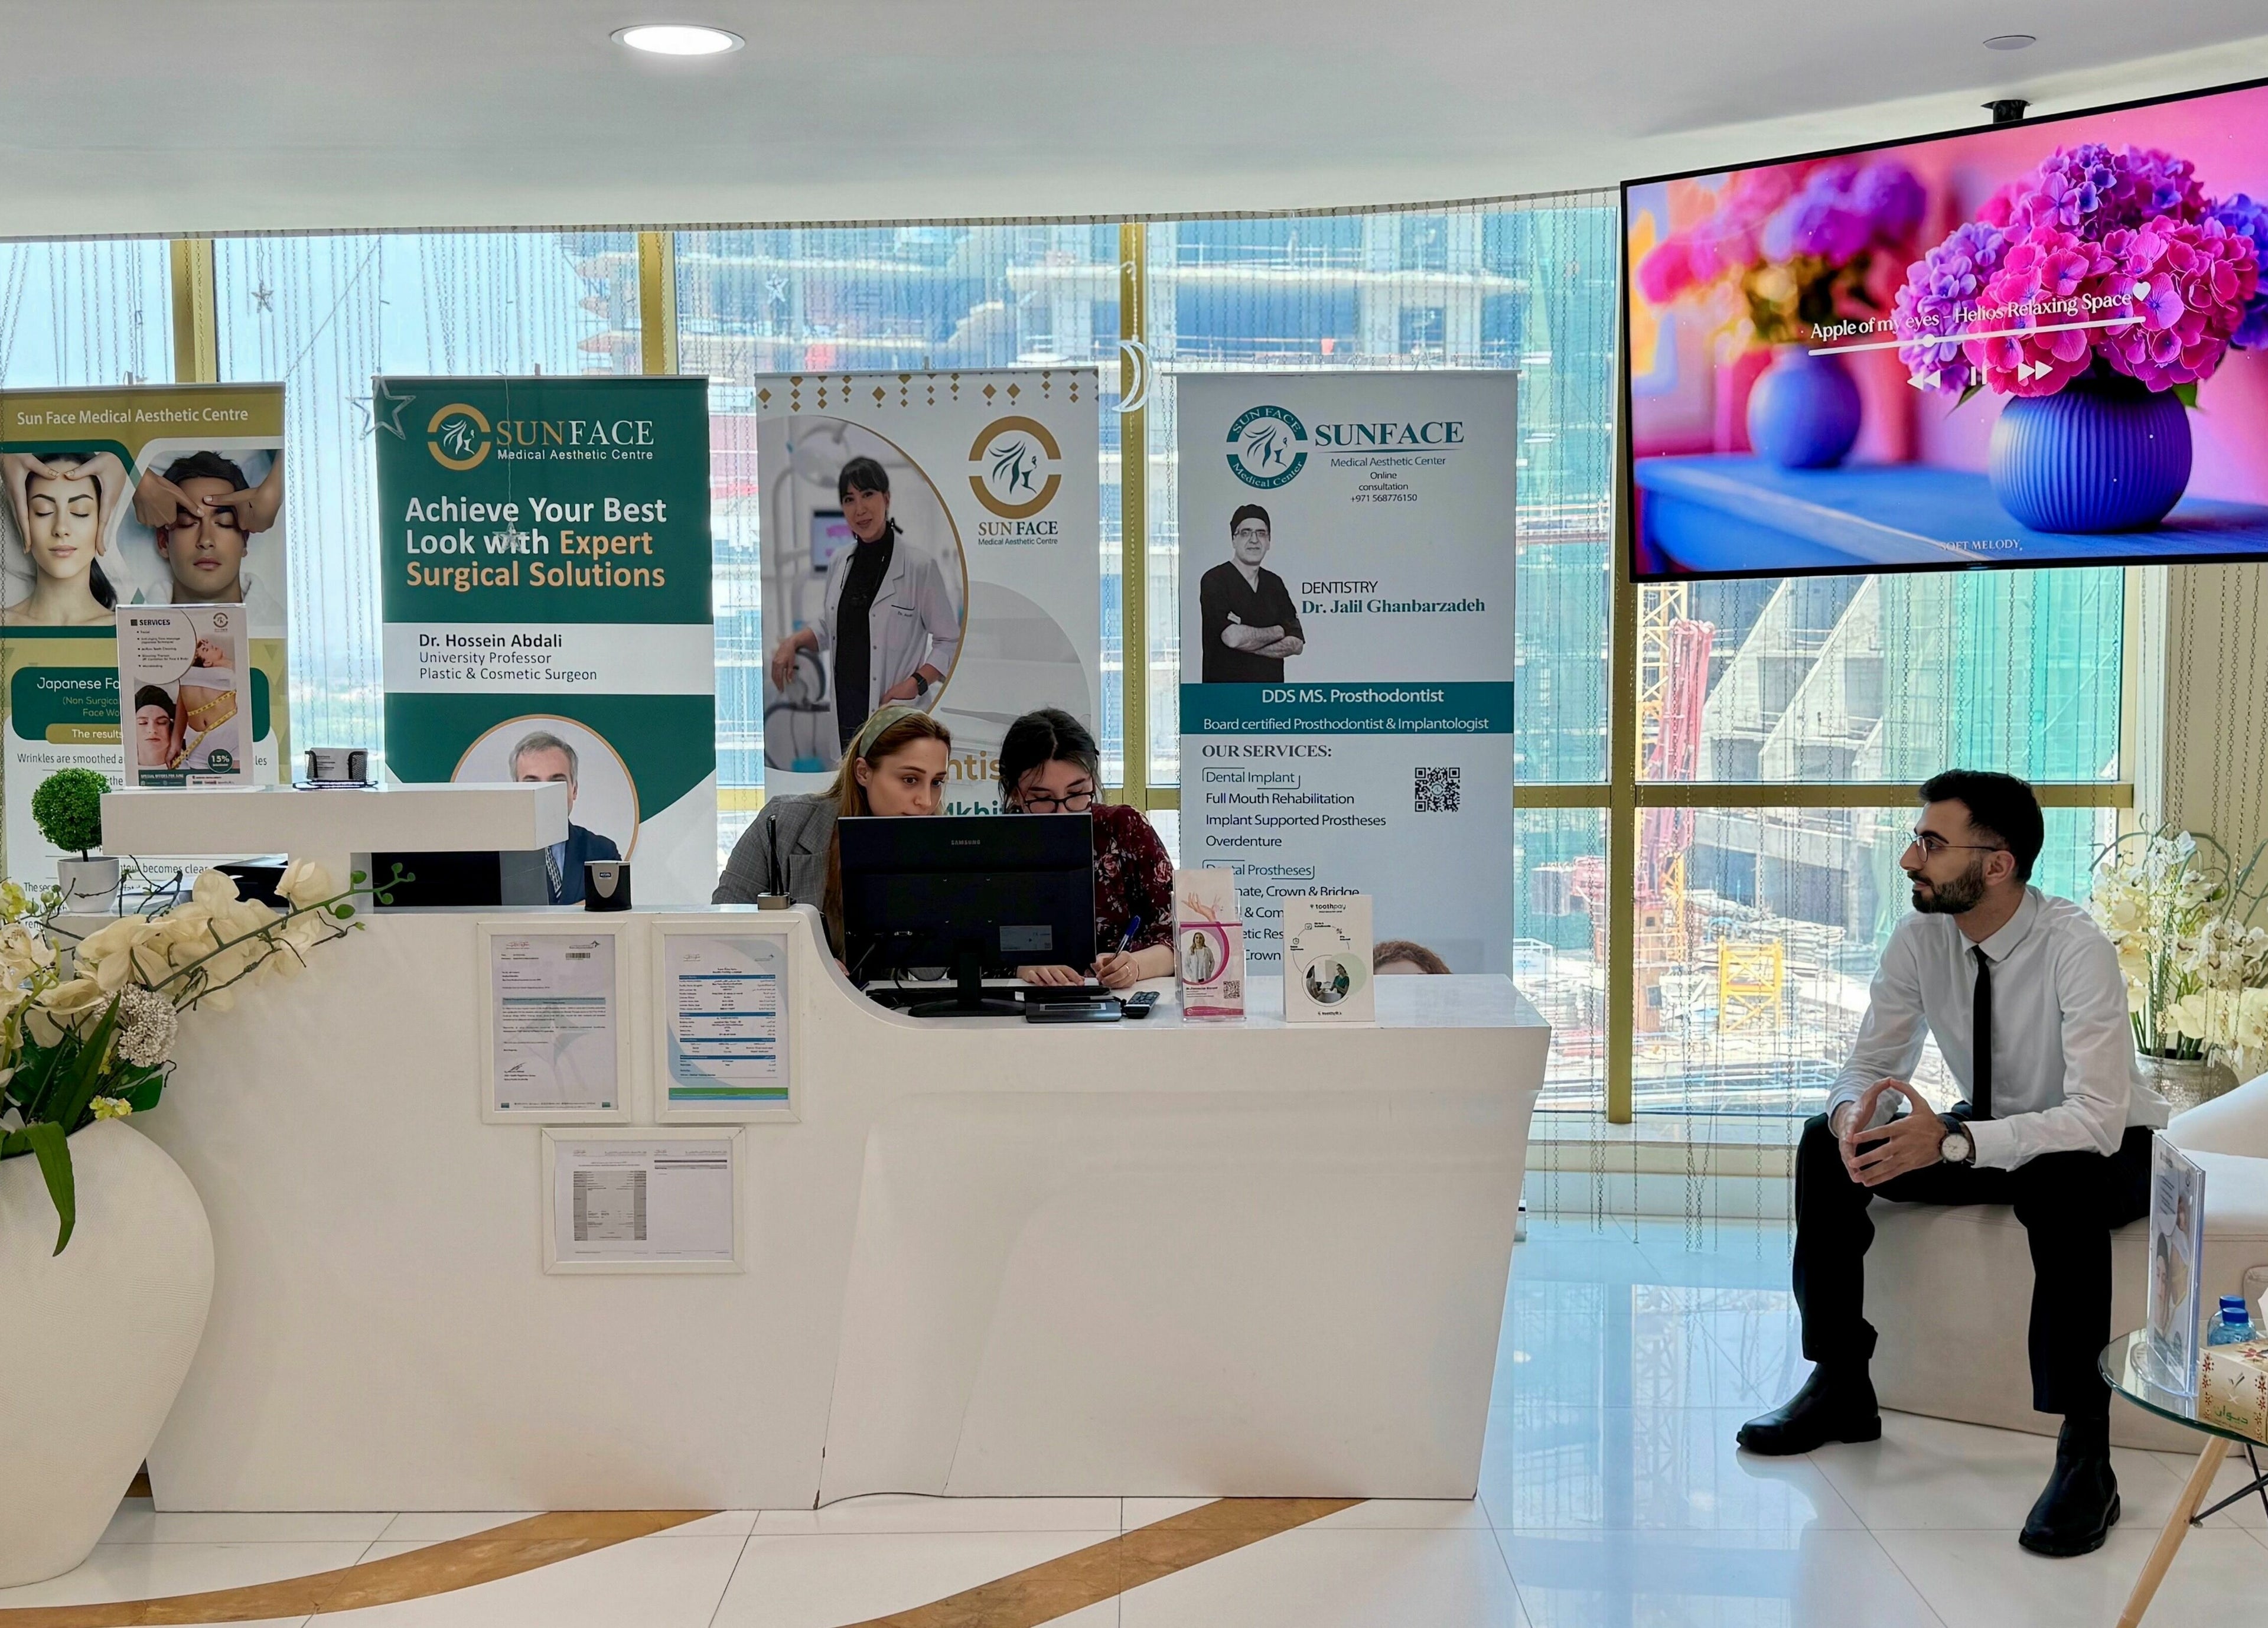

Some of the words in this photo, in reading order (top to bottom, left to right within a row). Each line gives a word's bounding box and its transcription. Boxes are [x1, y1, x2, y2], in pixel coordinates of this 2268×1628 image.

[1810, 320, 1857, 341] Apple
[1859, 317, 1875, 333] of
[1878, 320, 1902, 334] my
[1906, 314, 1940, 331] eyes
[1955, 307, 2004, 324] Helios
[2008, 298, 2077, 317] Relaxing
[2081, 293, 2132, 314] Space
[18, 412, 42, 425] Sun
[47, 412, 76, 424] Face
[80, 409, 131, 424] Medical
[135, 408, 199, 422] Aesthetic
[203, 408, 248, 421] Centre
[1233, 409, 1260, 433] SUN
[1265, 408, 1301, 432] FACE
[496, 420, 654, 446] SUNFACE
[1315, 422, 1464, 446] SUNFACE
[498, 450, 545, 460] Medical
[550, 450, 606, 460] Aesthetic
[612, 450, 653, 460] Centre
[1331, 457, 1367, 467] Medical
[1370, 457, 1413, 466] Aesthetic
[1415, 457, 1446, 465] Center
[1233, 463, 1269, 487] Medical
[1273, 461, 1302, 486] Center
[1351, 494, 1370, 503] +971
[405, 496, 519, 522] Achieve
[529, 497, 594, 522] Your
[604, 498, 666, 522] Best
[407, 529, 475, 553] Look
[561, 530, 653, 560] Expert
[1941, 541, 1969, 551] SOFT
[1972, 539, 2021, 549] MELODY
[407, 561, 518, 592] Surgical
[530, 559, 664, 587] Solutions
[1302, 581, 1378, 594] DENTISTRY
[1302, 601, 1326, 613] Dr.
[1330, 600, 1362, 613] Jalil
[1367, 598, 1485, 613] Ghanbarzadeh
[420, 634, 439, 646] Dr.
[447, 634, 505, 647] Hossein
[511, 634, 561, 647] Abdali
[420, 652, 485, 666] University
[490, 652, 552, 663] Professor
[421, 668, 461, 679] Plastic
[467, 668, 475, 679] &
[481, 668, 540, 679] Cosmetic
[545, 669, 597, 682] Surgeon
[37, 677, 101, 692] Japanese
[106, 678, 120, 689] Fa
[1263, 690, 1295, 702] DDS
[1299, 689, 1327, 702] MS.
[1331, 688, 1444, 702] Prosthodontist
[63, 696, 83, 705] (Non
[86, 696, 118, 708] Surgica
[83, 708, 104, 717] Face
[106, 708, 120, 717] Wo
[1204, 718, 1239, 730] Board
[1242, 718, 1291, 729] certified
[1294, 718, 1384, 729] Prosthodontist
[1386, 718, 1396, 729] &
[1399, 718, 1488, 732] Implantologist
[72, 729, 89, 738] The
[1203, 745, 1240, 757] OUR
[1243, 745, 1331, 757] SERVICES:
[17, 753, 54, 763] Wrinkles
[73, 753, 116, 764] smoothed
[948, 750, 1000, 780] ntis
[1207, 771, 1244, 782] Dental
[1248, 772, 1294, 785] Implant
[1207, 793, 1226, 803] Full
[1229, 793, 1269, 803] Mouth
[1273, 793, 1354, 804] Rehabilitation
[1207, 814, 1252, 827] Implant
[1255, 815, 1319, 828] Supported
[1322, 815, 1386, 825] Prostheses
[1206, 836, 1282, 846] Overdenture
[143, 863, 182, 873] becomes
[1249, 864, 1311, 877] Prostheses
[24, 882, 38, 892] The
[1240, 887, 1263, 898] nate,
[1266, 886, 1305, 897] Crown
[1309, 887, 1318, 896] &
[1321, 887, 1359, 896] Bridge
[1244, 907, 1253, 917] &
[1256, 907, 1283, 917] Com
[1243, 929, 1261, 939] etic
[1264, 929, 1283, 939] Res
